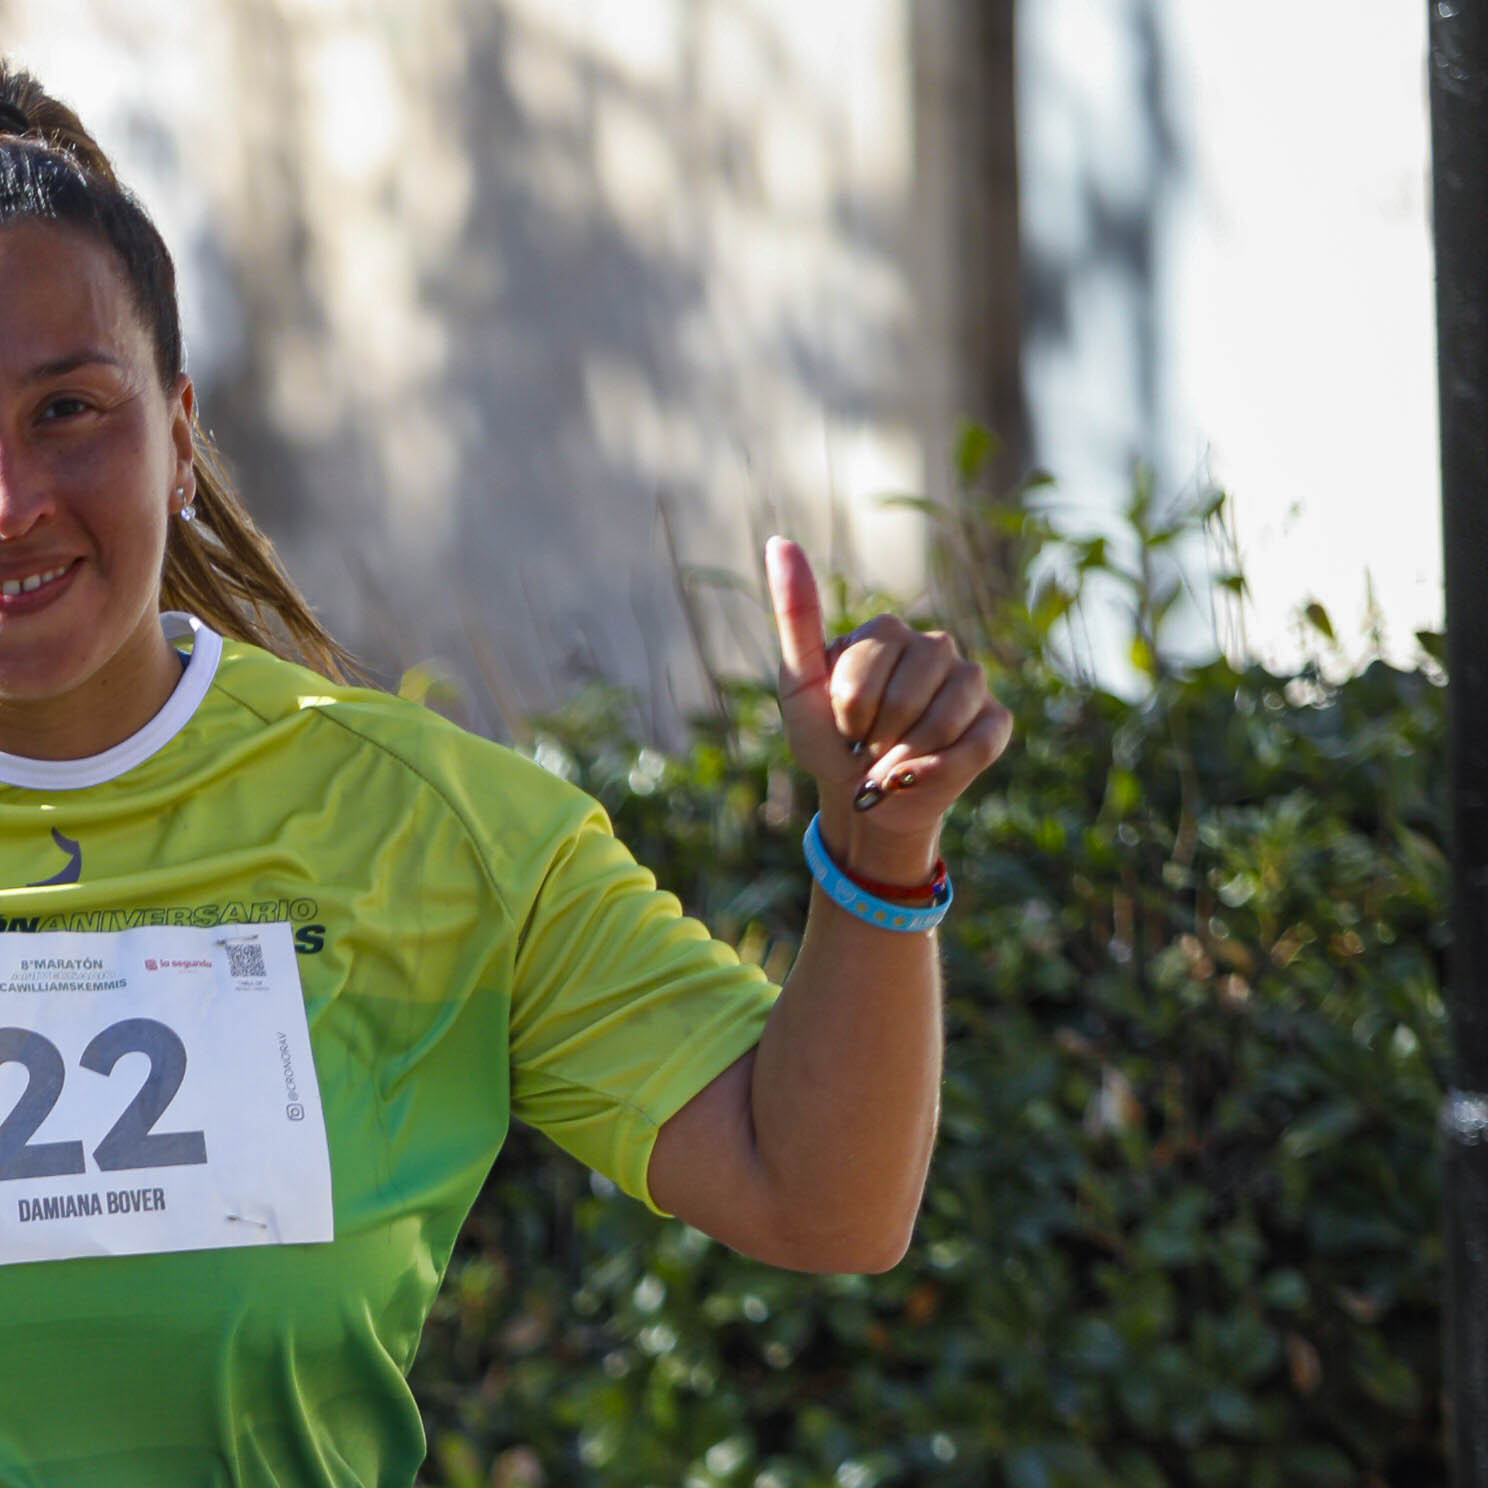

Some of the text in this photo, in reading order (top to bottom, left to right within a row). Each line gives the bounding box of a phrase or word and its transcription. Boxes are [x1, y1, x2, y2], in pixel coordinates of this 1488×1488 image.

[0, 978, 127, 992] CAWILLIAMSKEMMIS
[18, 1187, 166, 1222] DAMIANA BOVER
